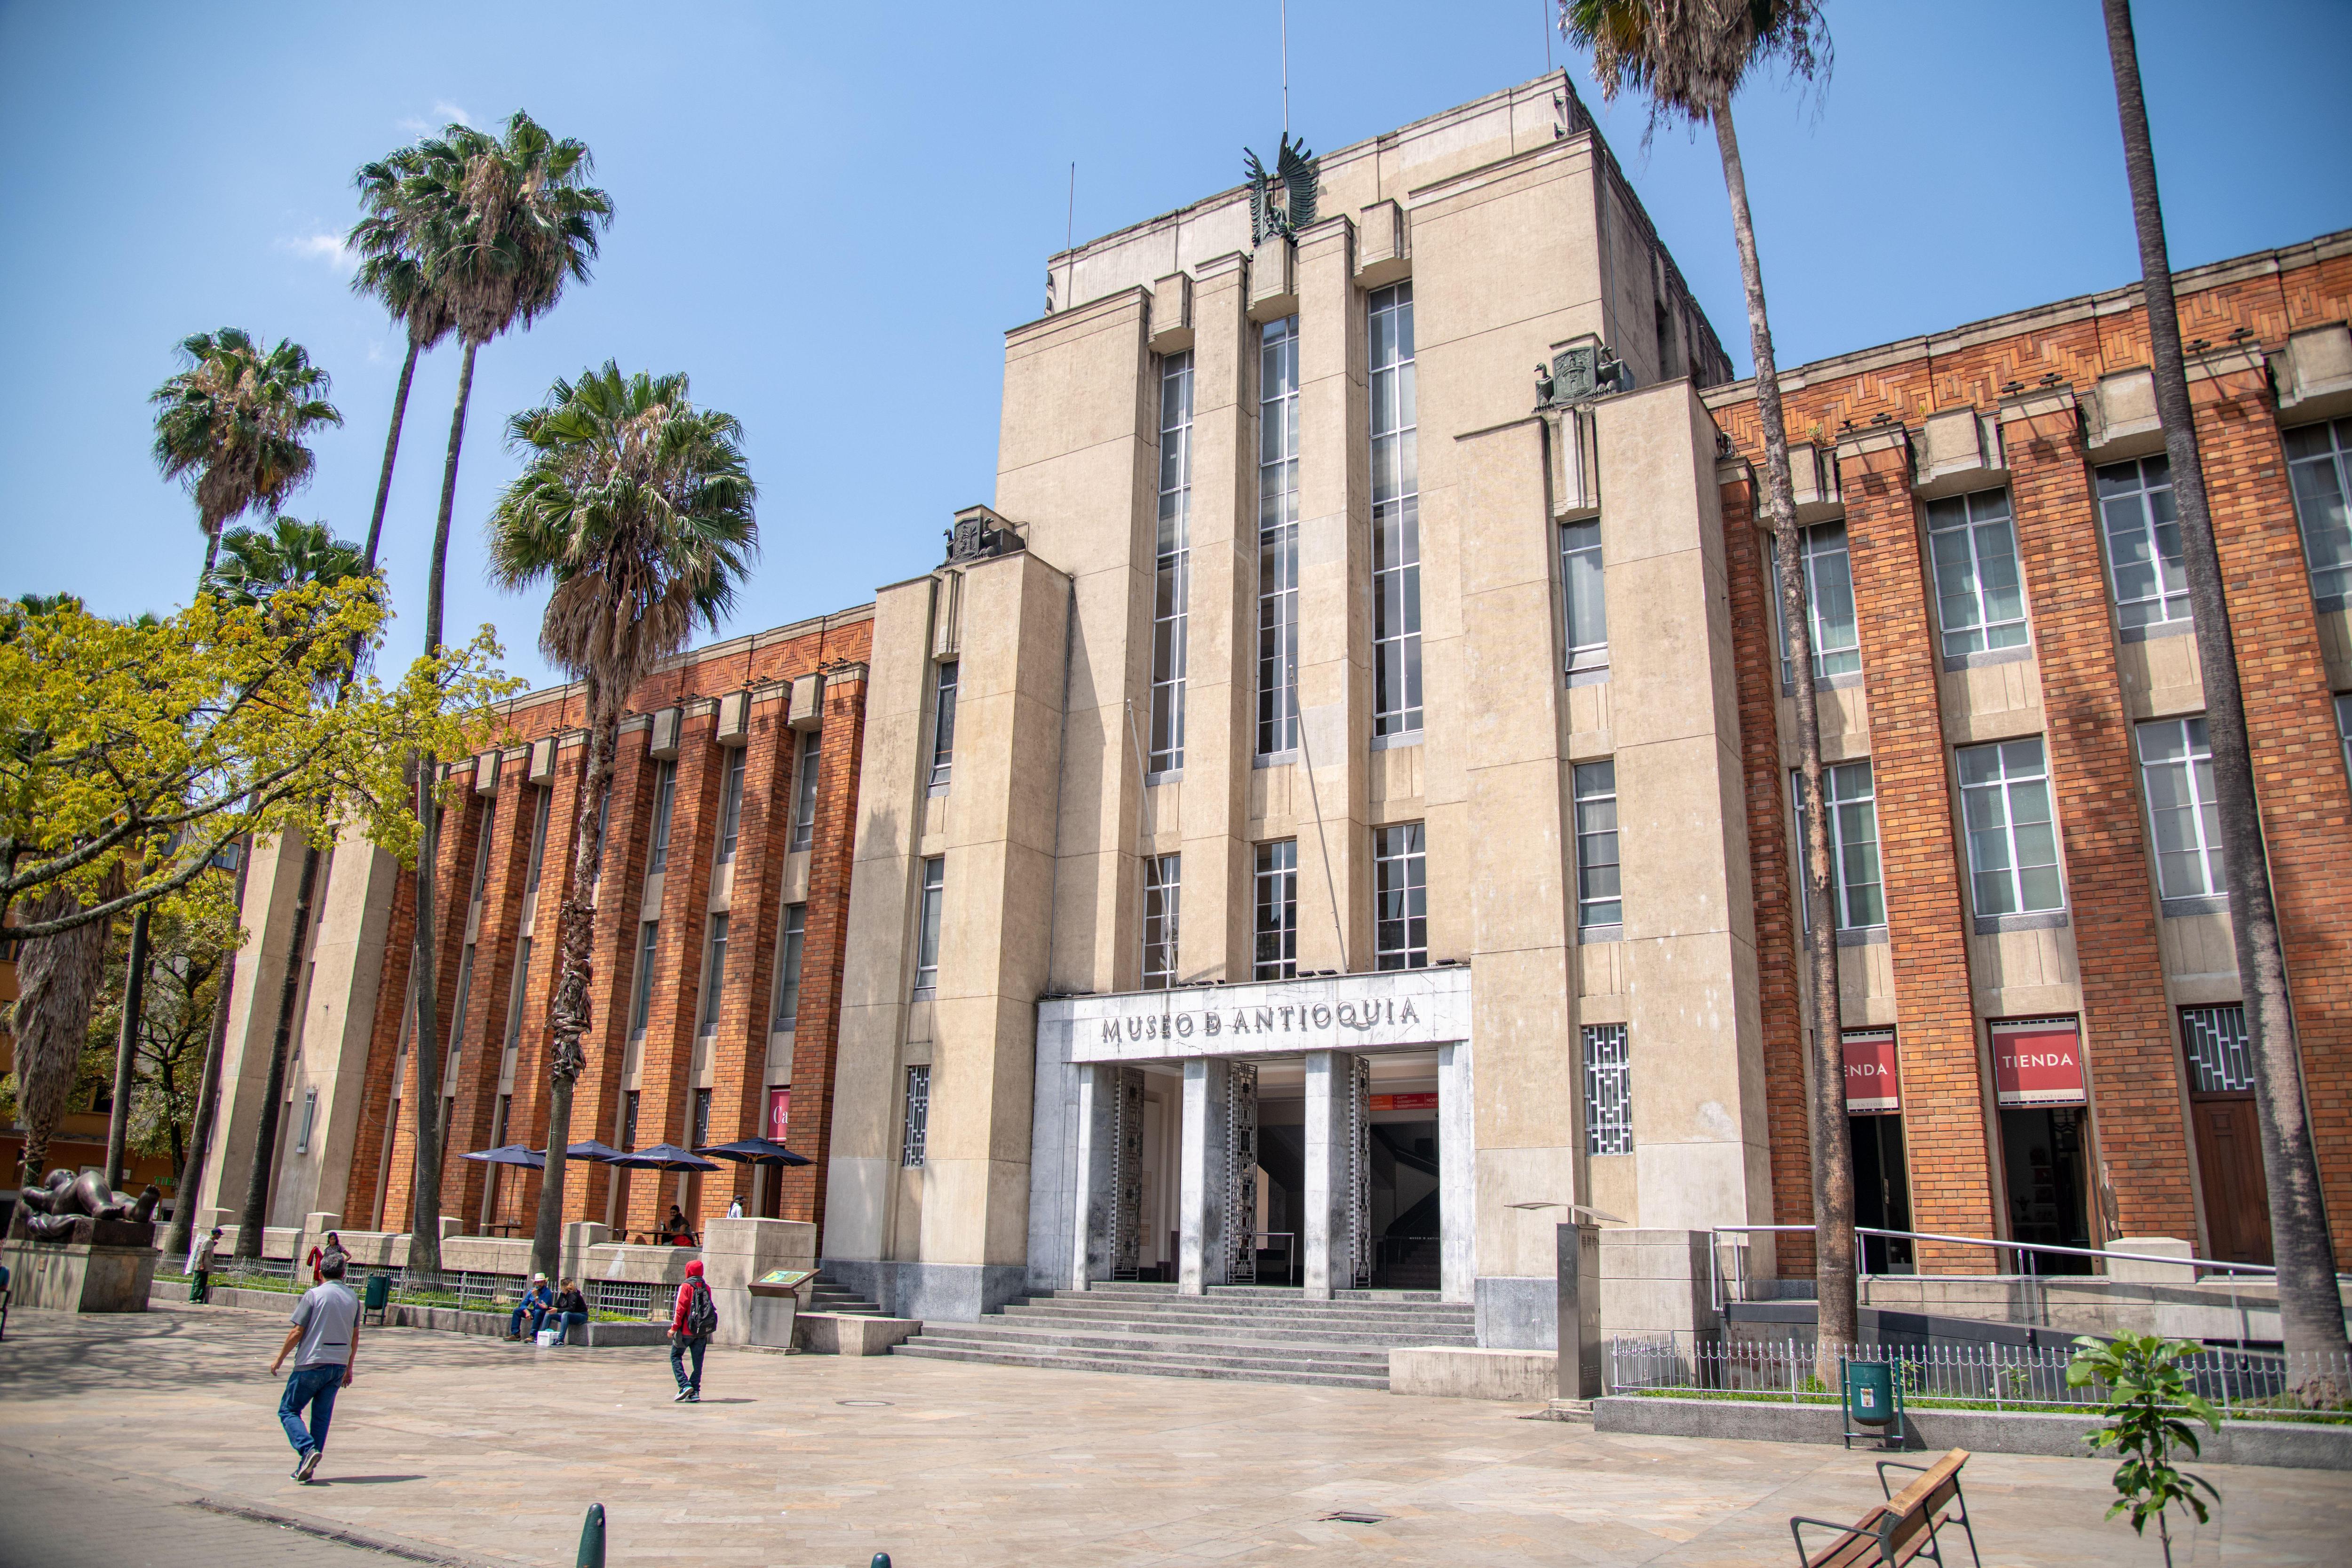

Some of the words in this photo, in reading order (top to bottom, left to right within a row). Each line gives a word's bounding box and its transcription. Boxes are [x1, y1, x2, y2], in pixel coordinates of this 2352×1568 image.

[1101, 1013, 1192, 1037] MUSEO
[1232, 996, 1418, 1028] ANTIOQUIA
[2002, 1053, 2074, 1068] TIENDA
[773, 1106, 788, 1124] Ca
